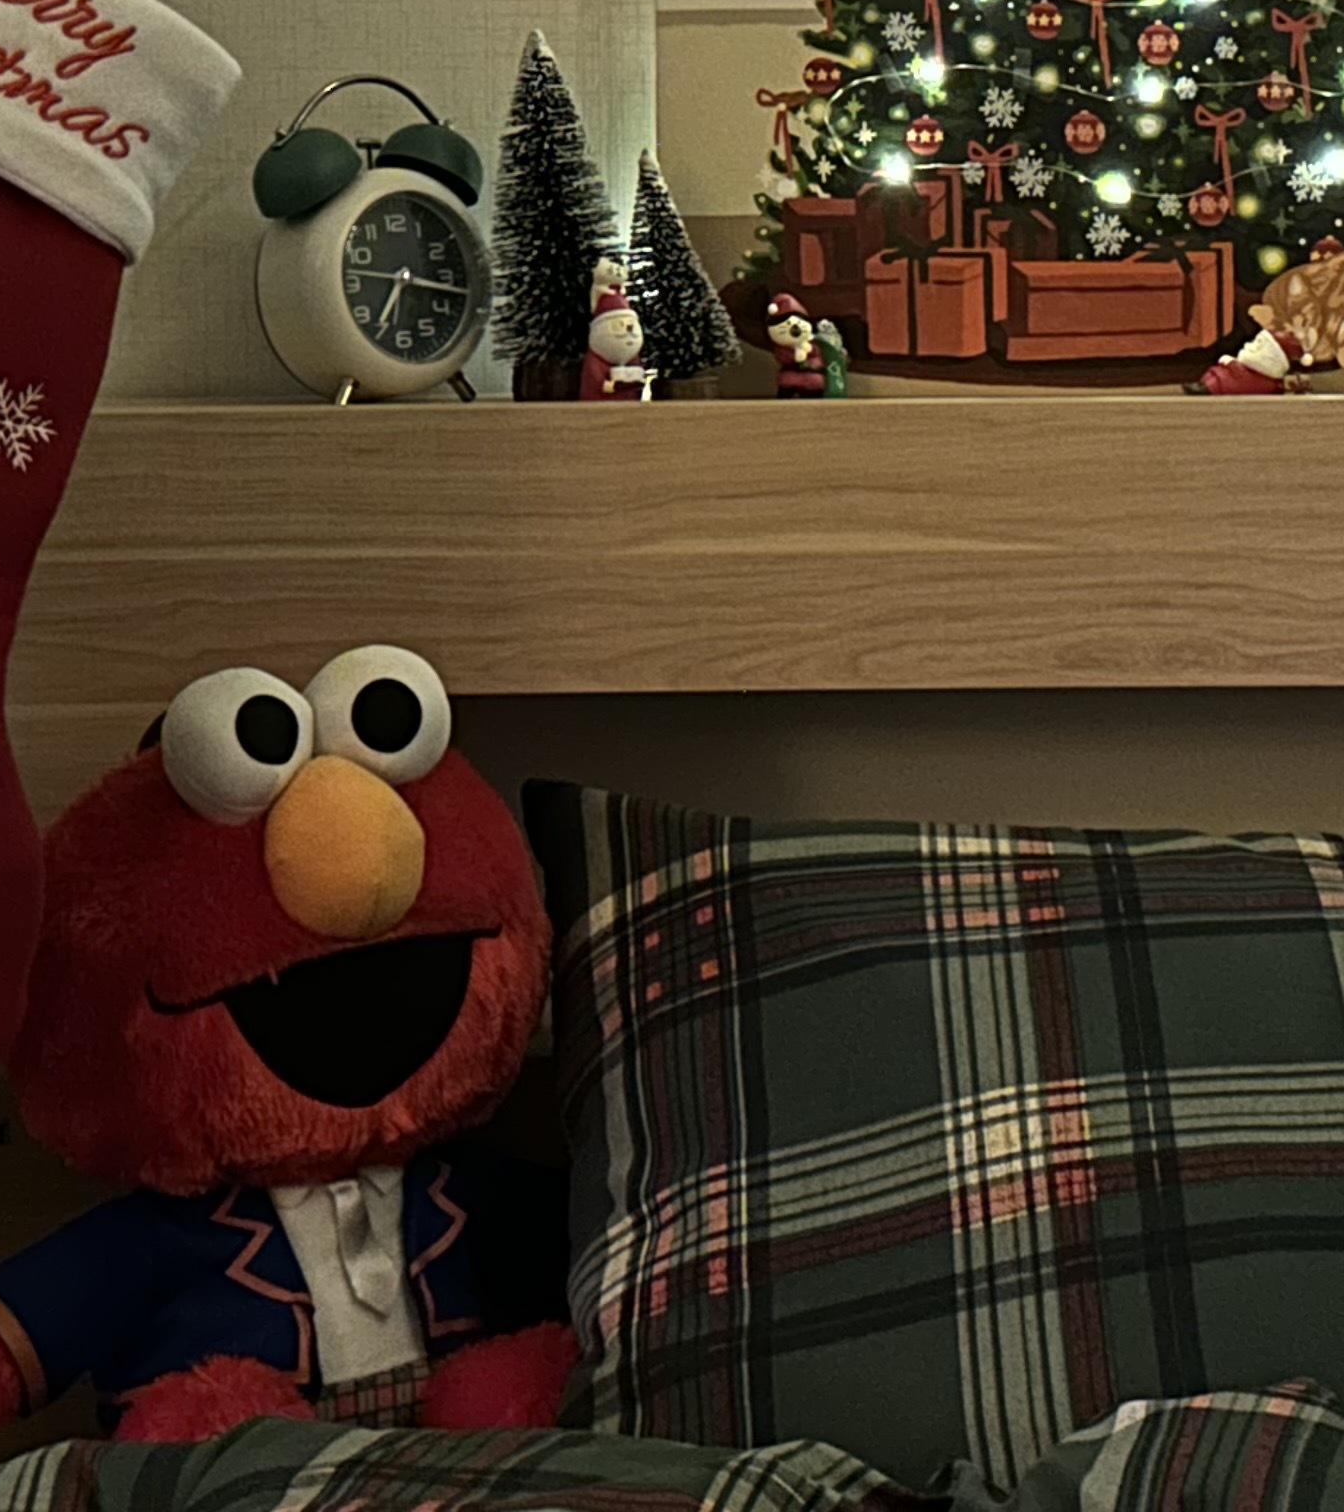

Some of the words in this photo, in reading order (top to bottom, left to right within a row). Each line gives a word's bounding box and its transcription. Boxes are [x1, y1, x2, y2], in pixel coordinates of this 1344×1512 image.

[384, 214, 407, 233] 12
[428, 242, 446, 261] 2
[432, 298, 451, 316] 4
[417, 318, 436, 337] 5
[395, 330, 413, 349] 6
